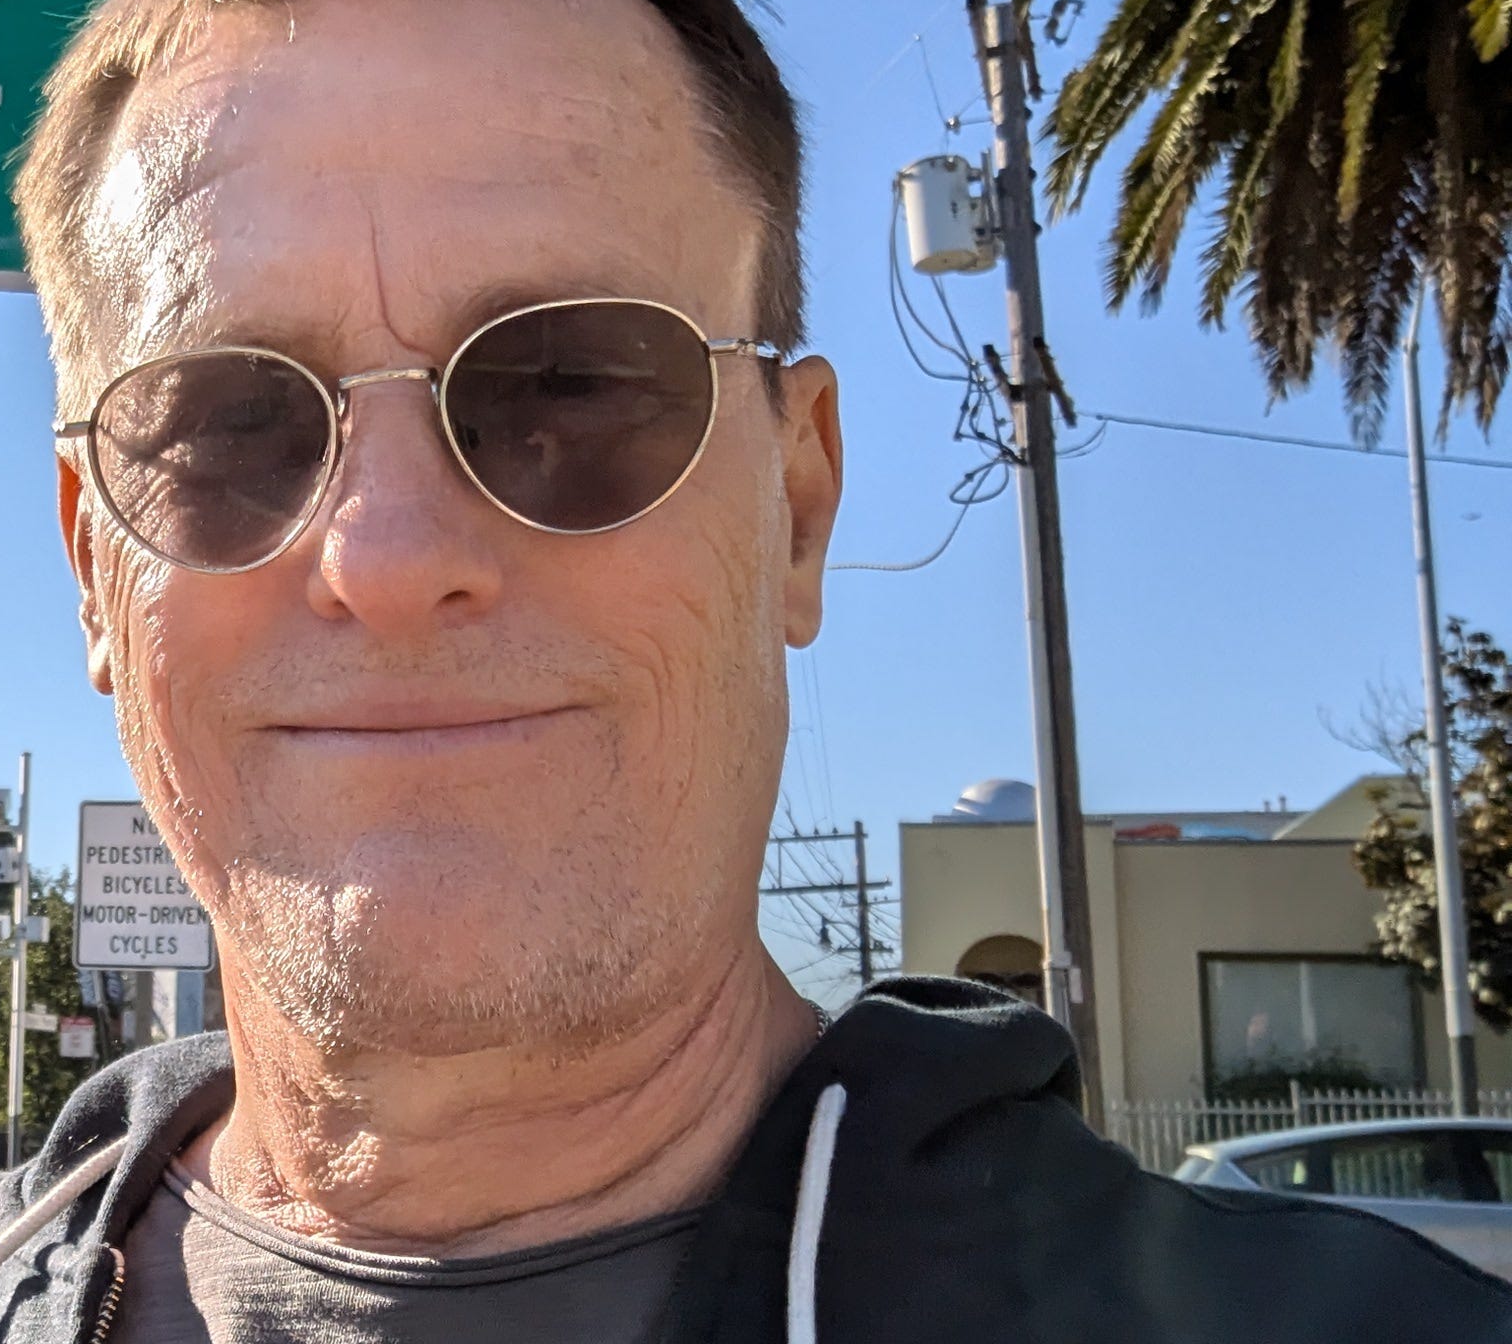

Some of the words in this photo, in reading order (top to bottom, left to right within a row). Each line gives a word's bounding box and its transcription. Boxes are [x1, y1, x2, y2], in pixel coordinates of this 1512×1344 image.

[102, 876, 188, 895] BICYCLES
[82, 905, 208, 925] MOTOR-DRIVEN
[109, 935, 178, 955] CYCLES
